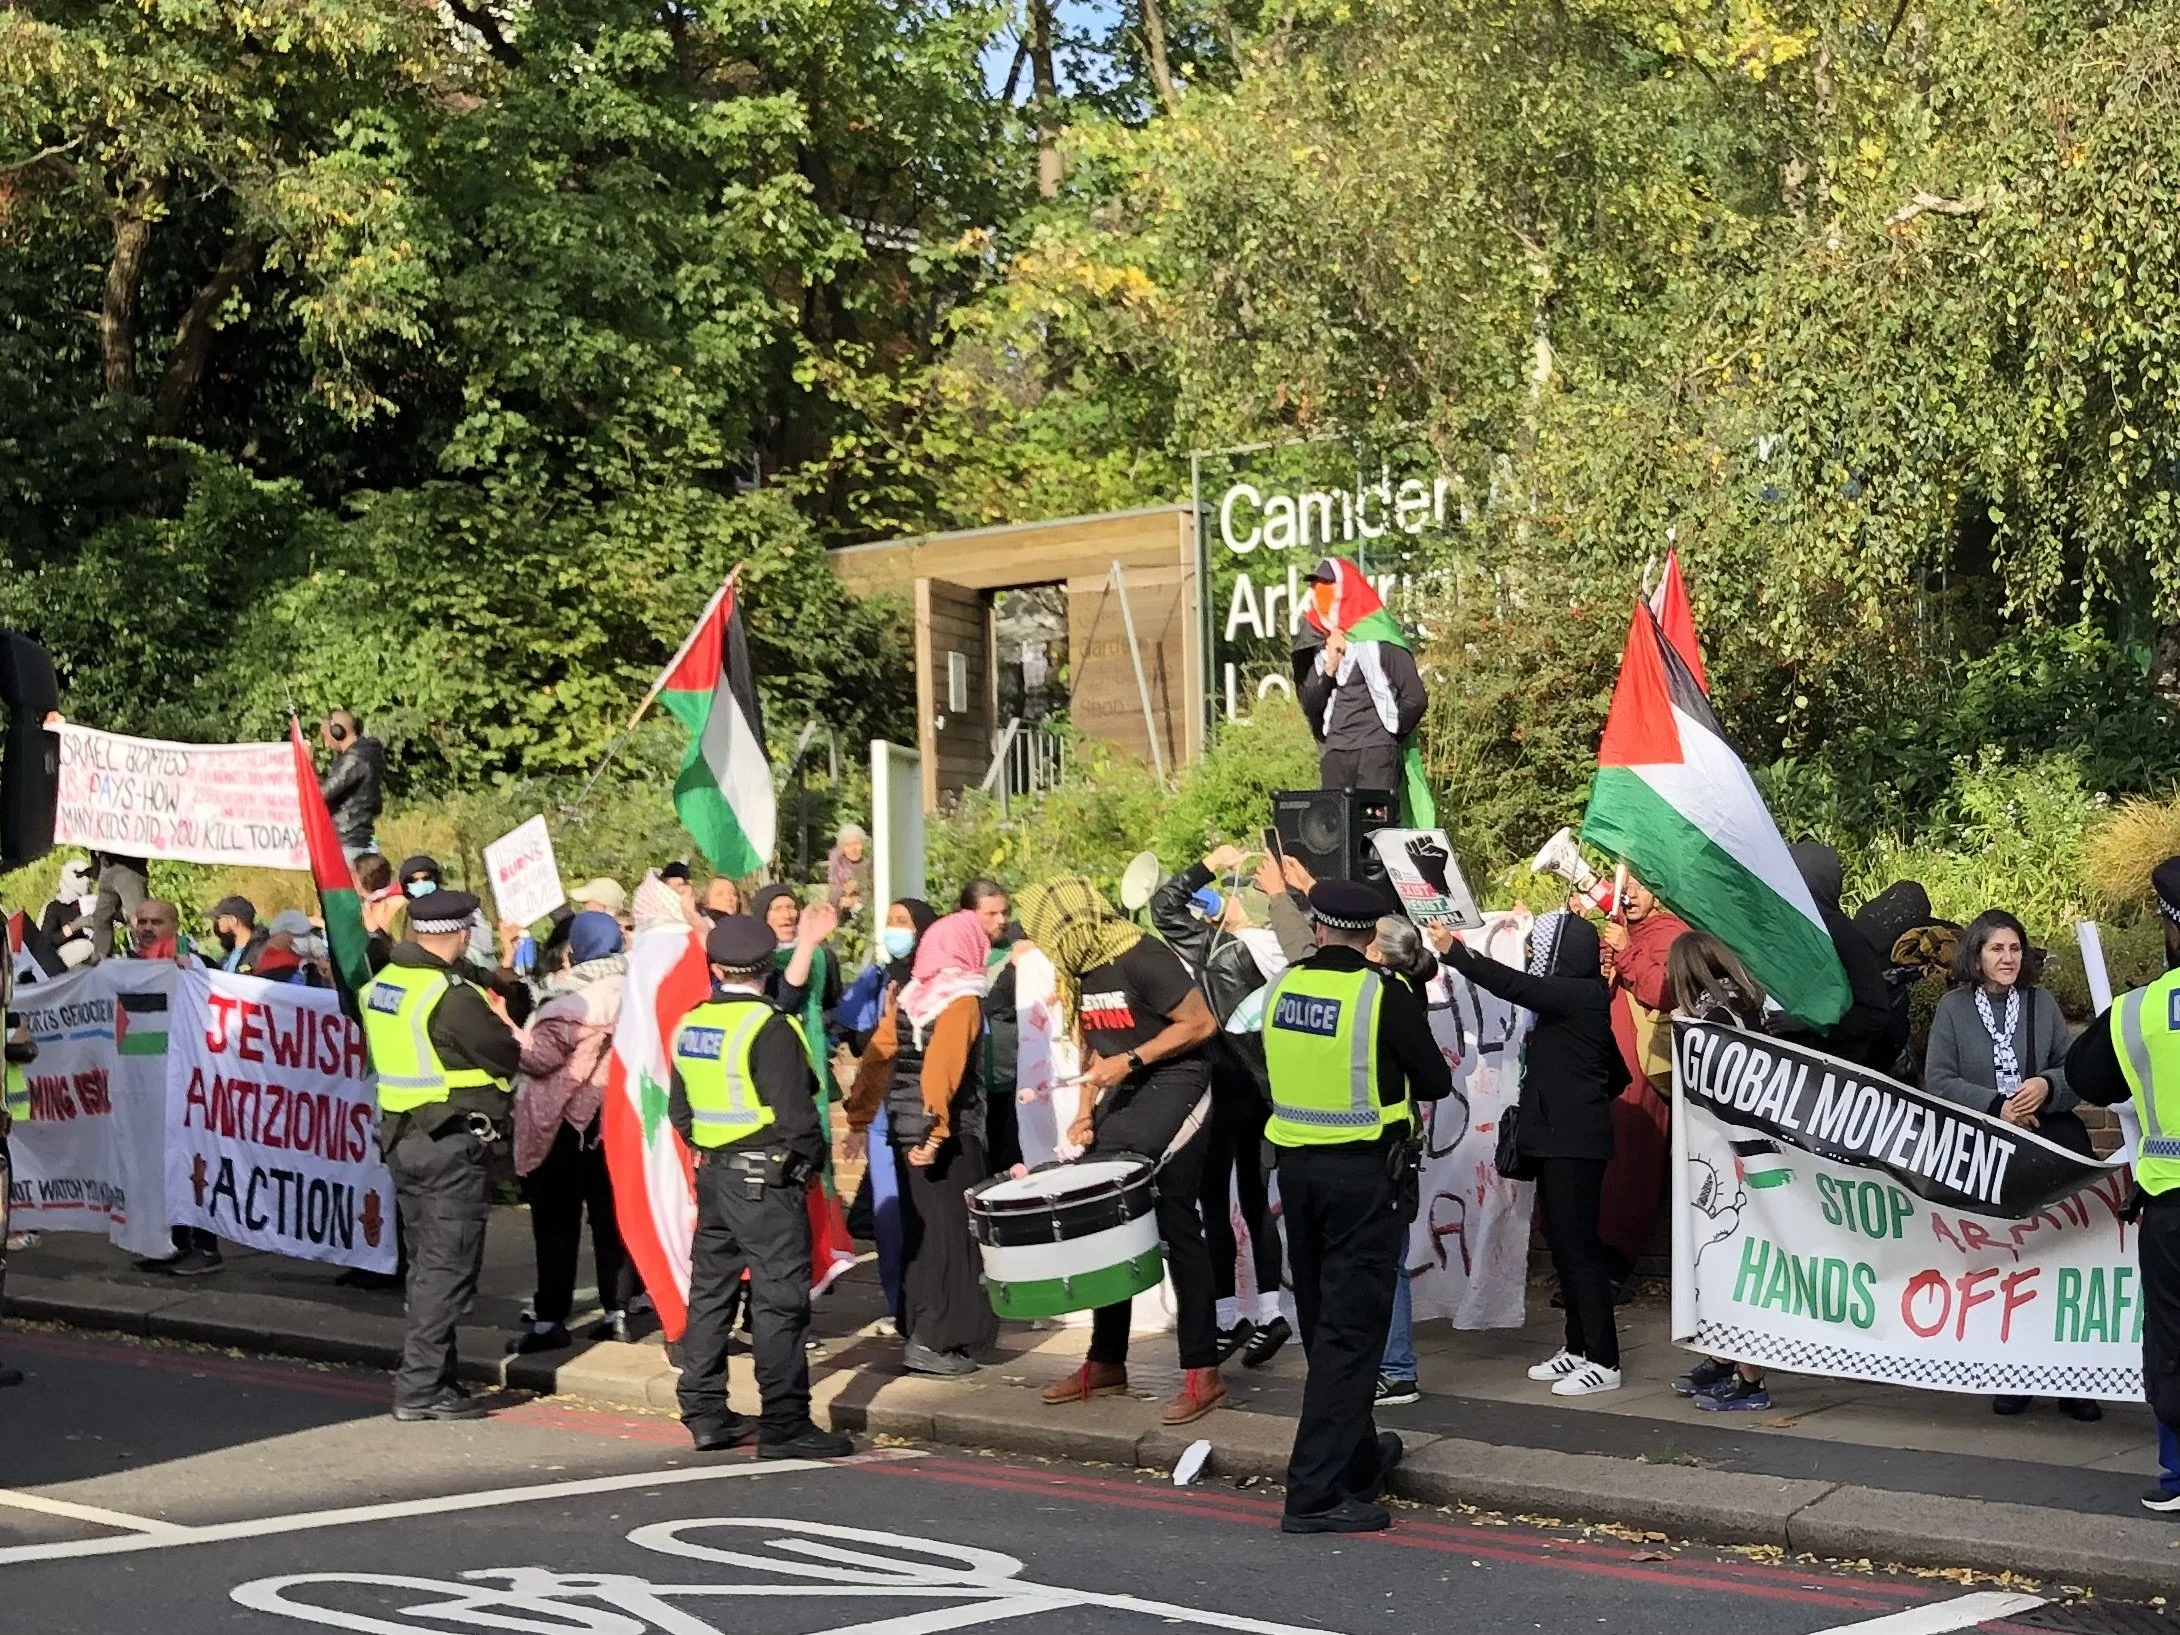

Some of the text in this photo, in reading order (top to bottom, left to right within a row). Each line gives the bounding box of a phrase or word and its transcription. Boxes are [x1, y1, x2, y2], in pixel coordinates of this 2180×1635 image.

[59, 733, 119, 772] SRAEL
[97, 810, 129, 841] KIDS
[135, 813, 161, 844] DID
[169, 817, 199, 848] YOU
[203, 820, 244, 851] KILL
[1081, 990, 1128, 1012] ESTINE
[1275, 998, 1337, 1030] POLICE
[206, 993, 368, 1082] JEWISH
[28, 1074, 77, 1121] MING
[184, 1066, 374, 1163] ANTIZIONIS
[1683, 1027, 2017, 1206] GLOBAL MOVEMENT
[210, 1157, 354, 1250] ACTION
[1816, 1171, 1915, 1240] STOP
[1732, 1236, 1877, 1330] HANDS
[1901, 1266, 2041, 1344] OFF
